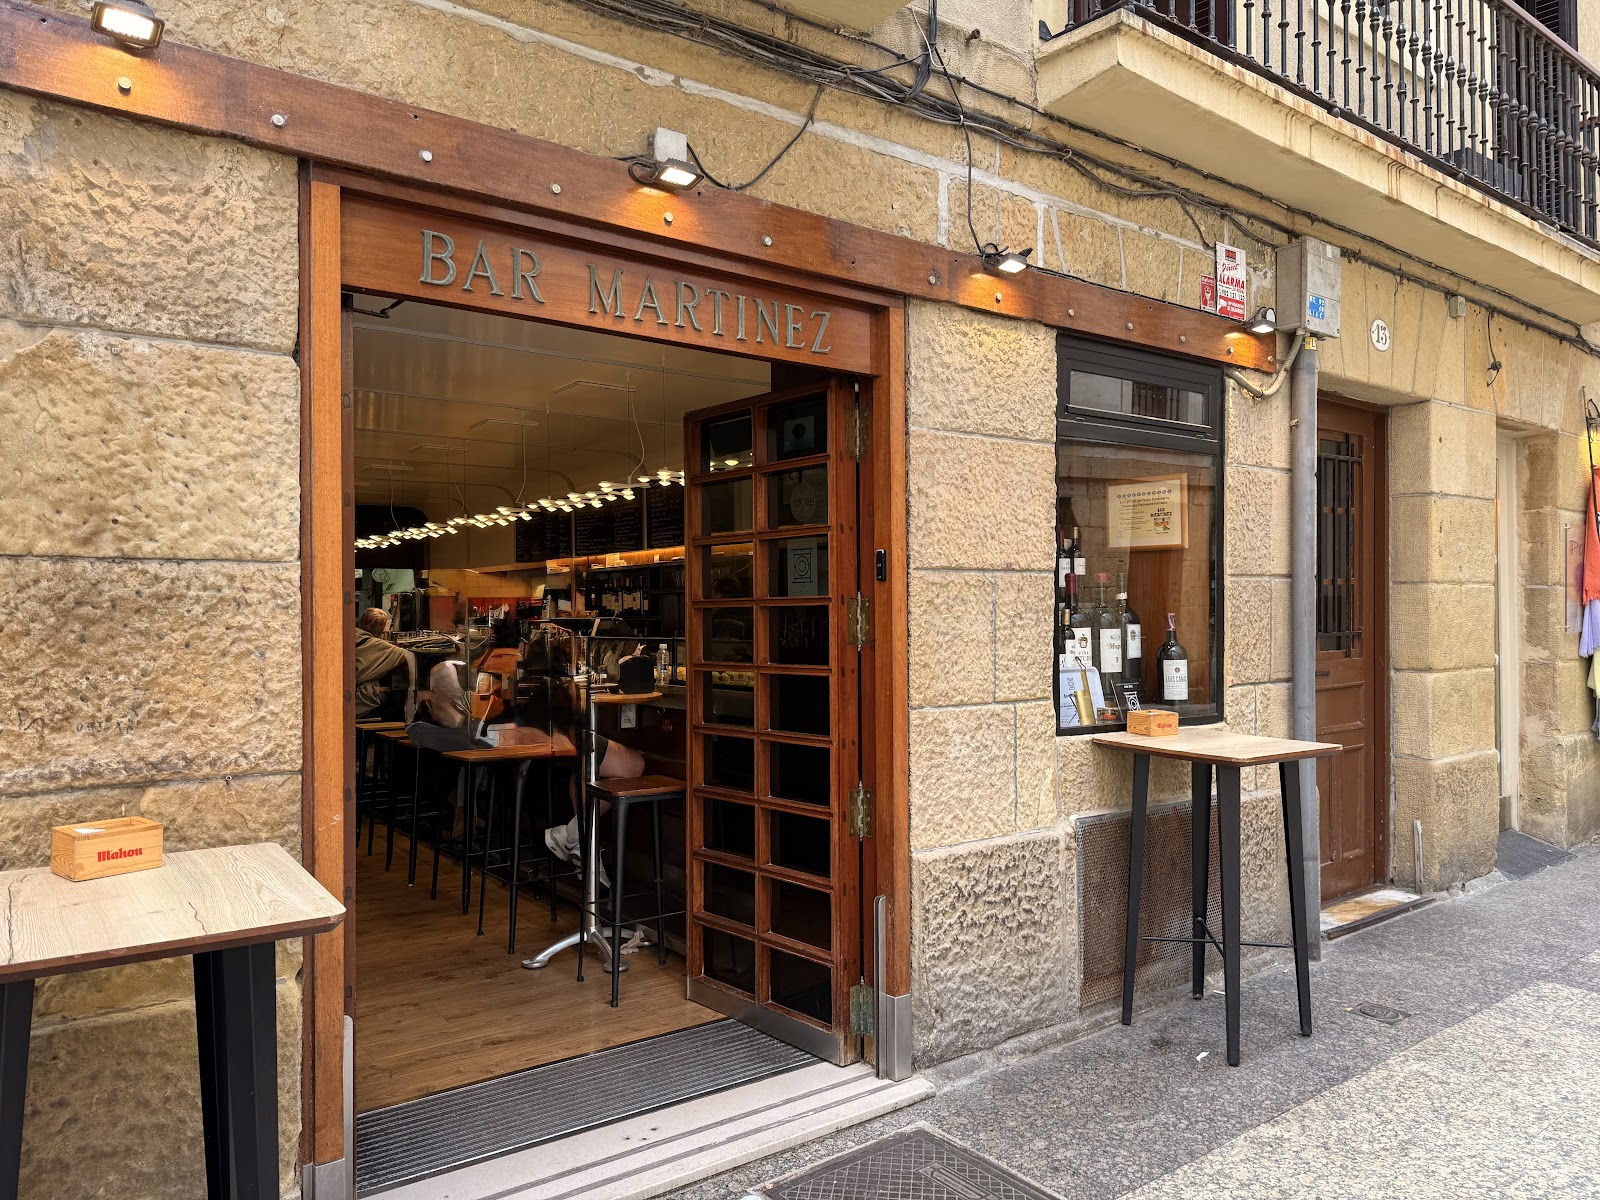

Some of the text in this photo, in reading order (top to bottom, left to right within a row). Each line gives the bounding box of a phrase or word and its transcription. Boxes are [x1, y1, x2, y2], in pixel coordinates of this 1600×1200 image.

[1218, 273, 1245, 289] ALARMA
[419, 229, 832, 354] BAR MARTINEZ
[1372, 324, 1387, 345] 13
[97, 847, 143, 862] Mahou
